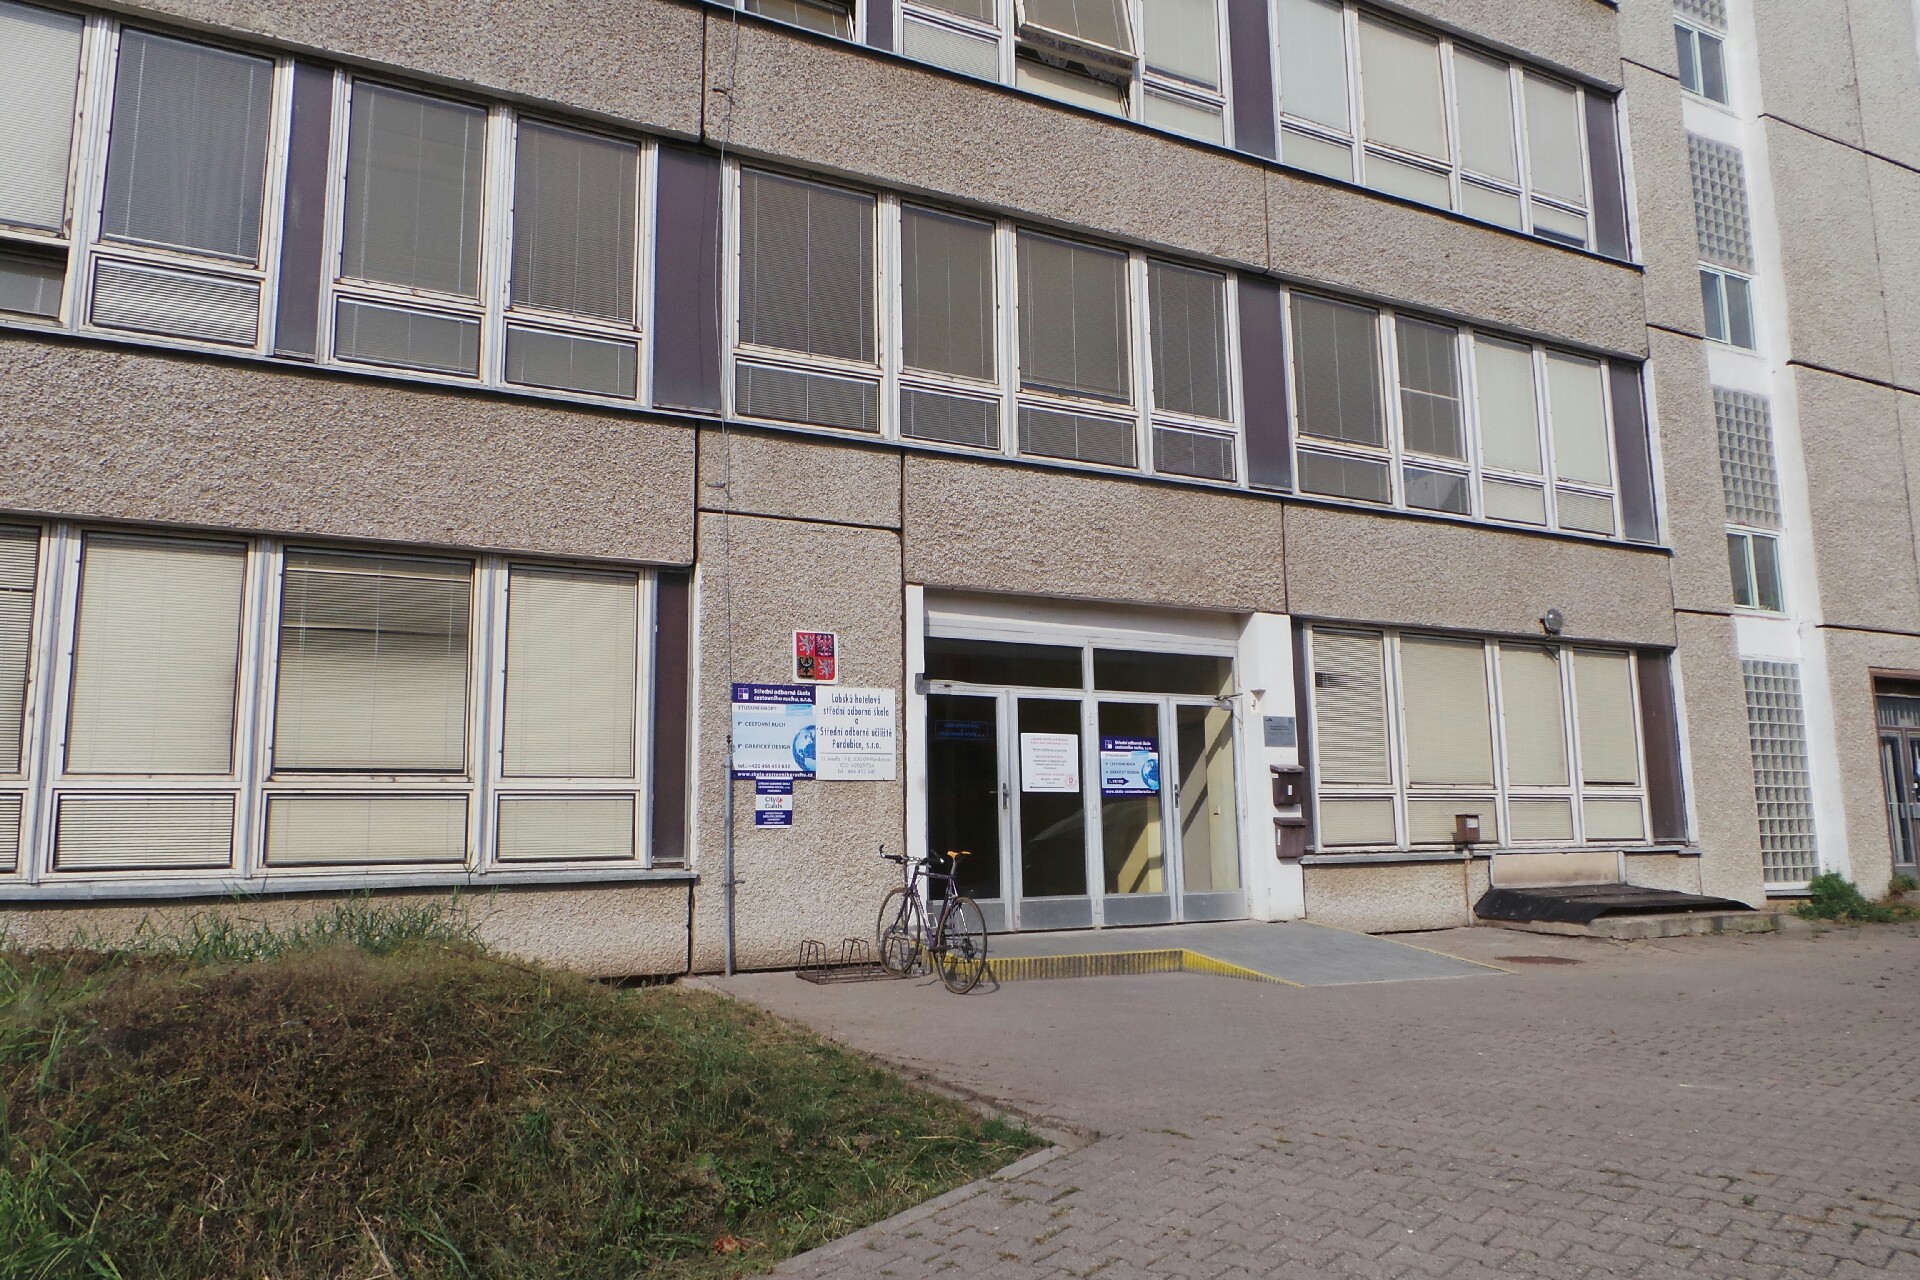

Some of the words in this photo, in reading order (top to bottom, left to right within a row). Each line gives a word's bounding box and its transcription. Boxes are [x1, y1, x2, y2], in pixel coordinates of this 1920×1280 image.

[832, 693, 853, 703] Labská
[854, 694, 881, 704] hotelová
[823, 706, 845, 715] střední
[847, 706, 871, 716] odborná
[873, 707, 889, 716] škola
[820, 726, 843, 736] Střední
[845, 727, 869, 737] odborné
[871, 728, 893, 737] učiliště
[832, 739, 864, 750] Pardubice,
[866, 742, 882, 750] s.r.o.
